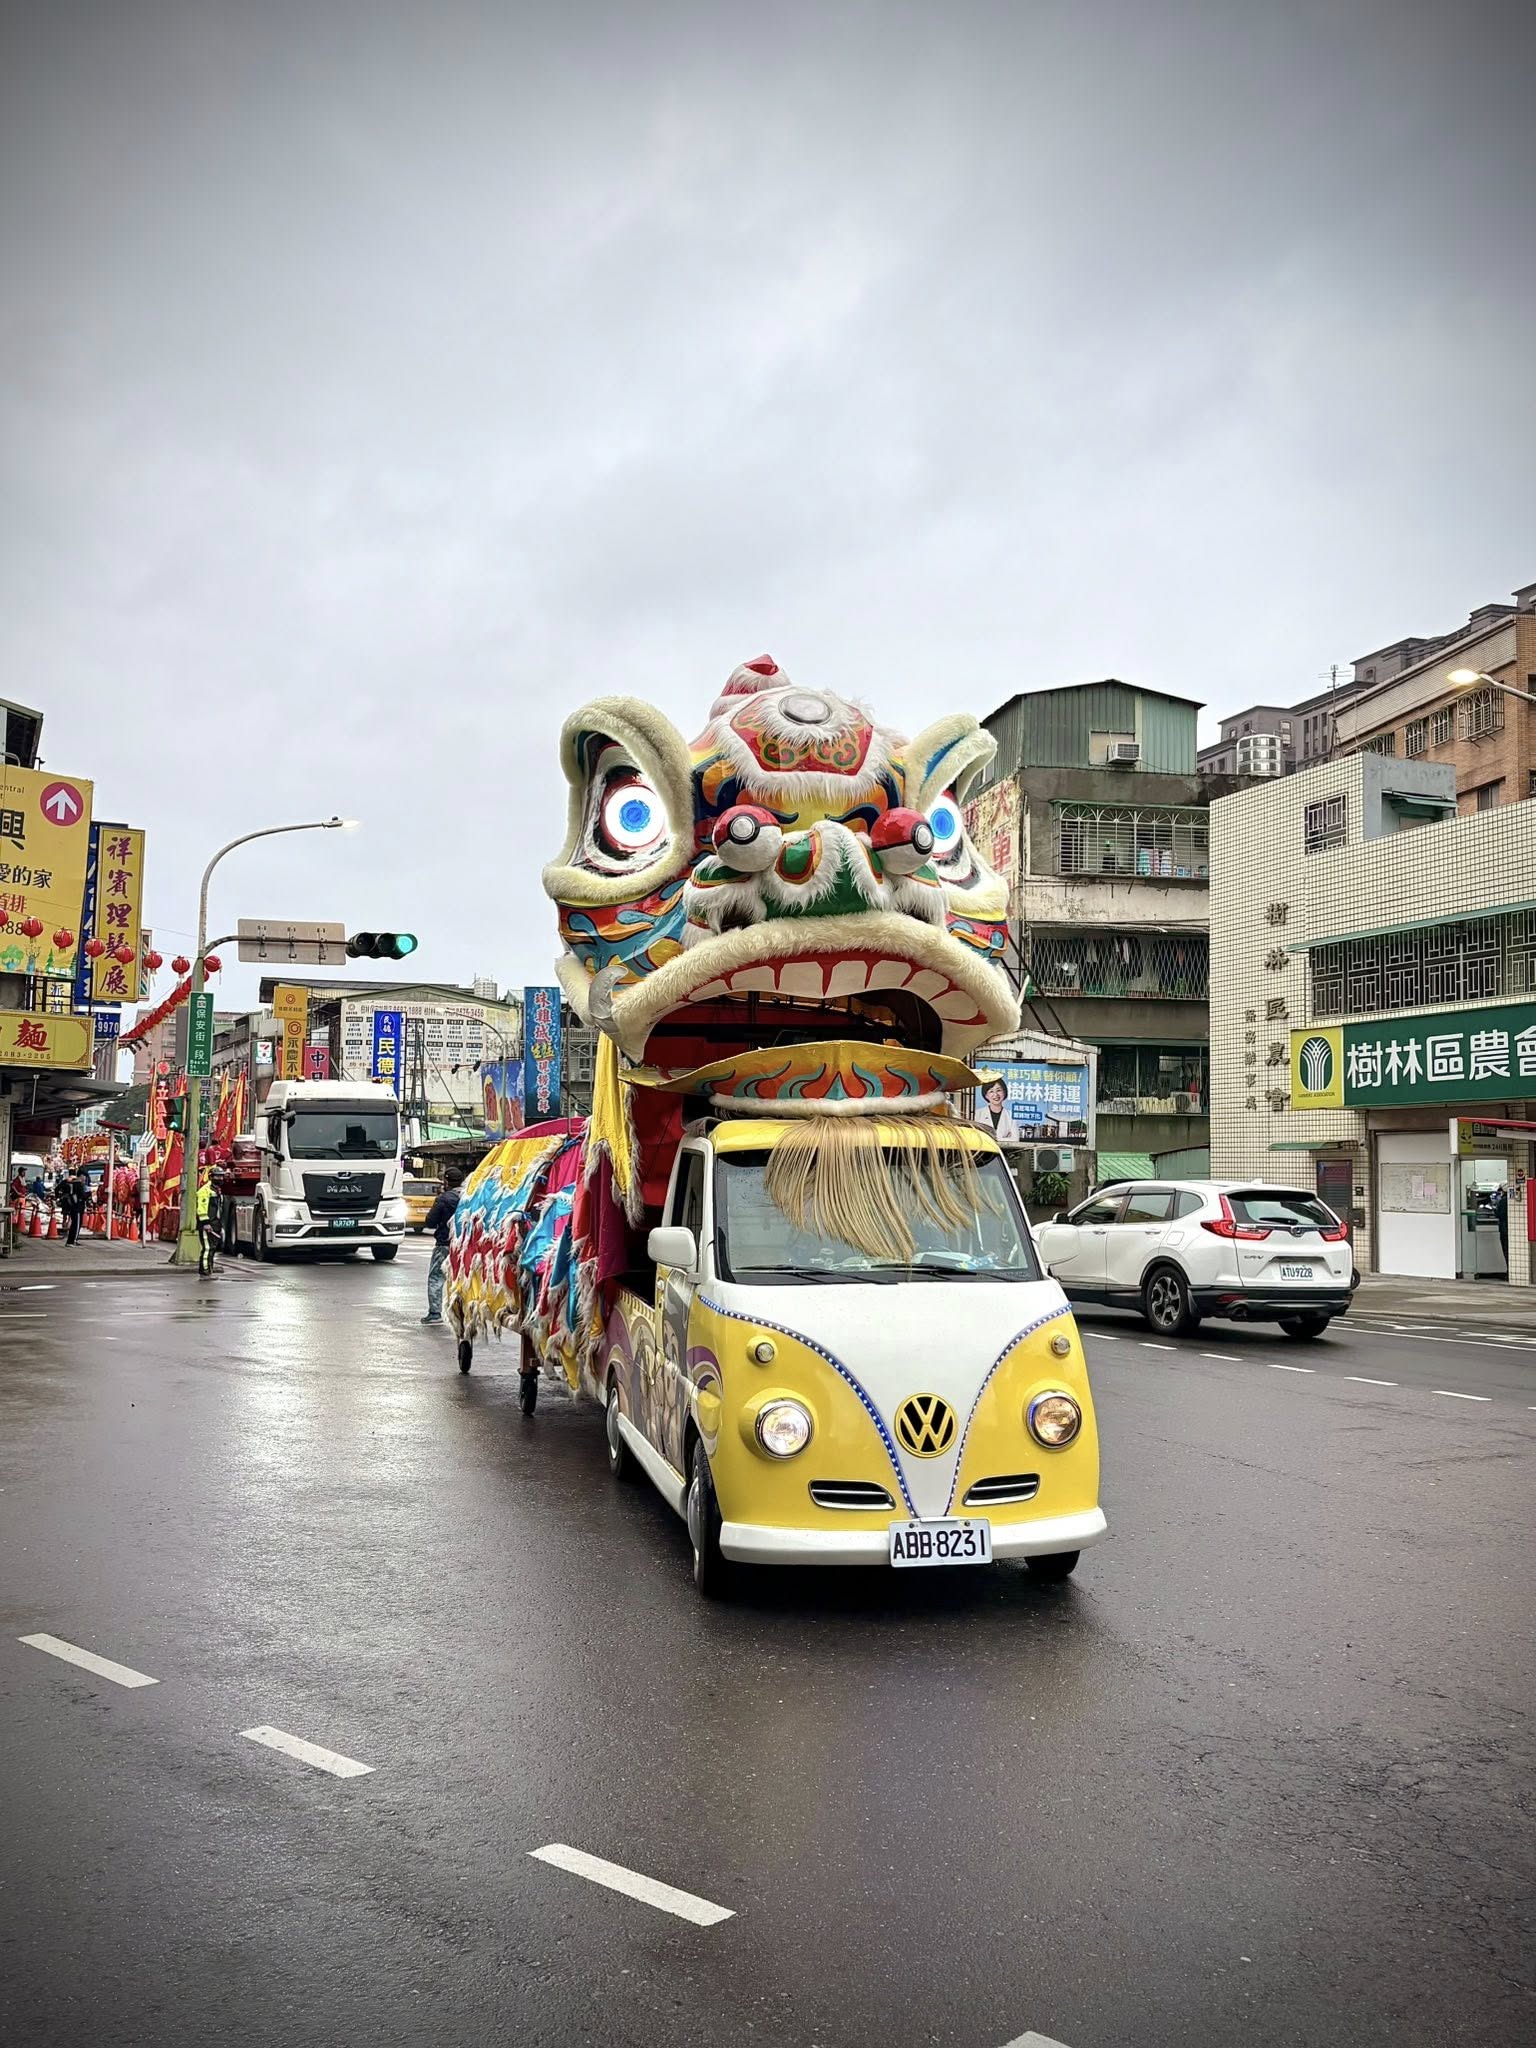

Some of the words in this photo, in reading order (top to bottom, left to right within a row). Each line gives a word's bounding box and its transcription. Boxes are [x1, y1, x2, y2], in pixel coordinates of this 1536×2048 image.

[1265, 902, 1290, 1111] 樹林區農會
[1007, 1082, 1081, 1104] 樹林捷運
[327, 1184, 362, 1193] MAN
